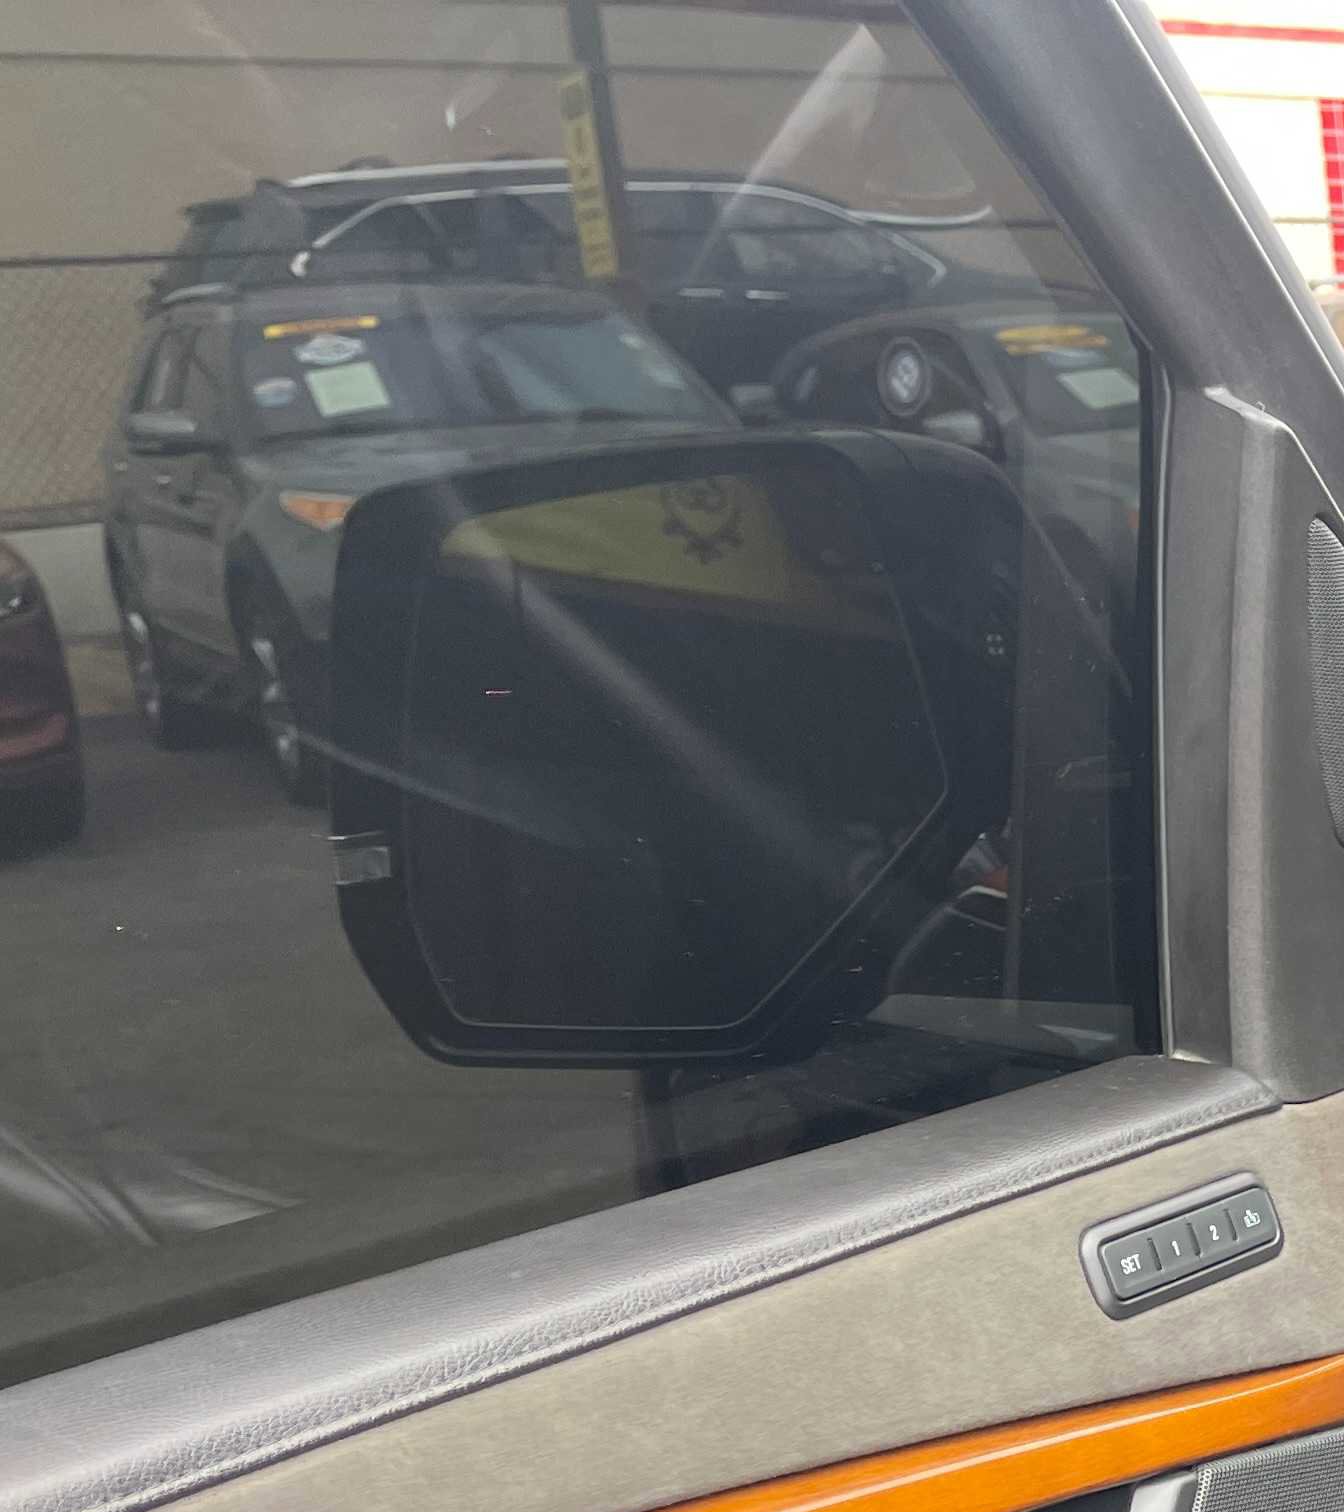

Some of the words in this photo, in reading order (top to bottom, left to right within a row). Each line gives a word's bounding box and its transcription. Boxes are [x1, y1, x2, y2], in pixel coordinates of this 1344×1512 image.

[1120, 1253, 1142, 1276] SET
[1171, 1240, 1181, 1257] 1
[1208, 1224, 1220, 1241] 2
